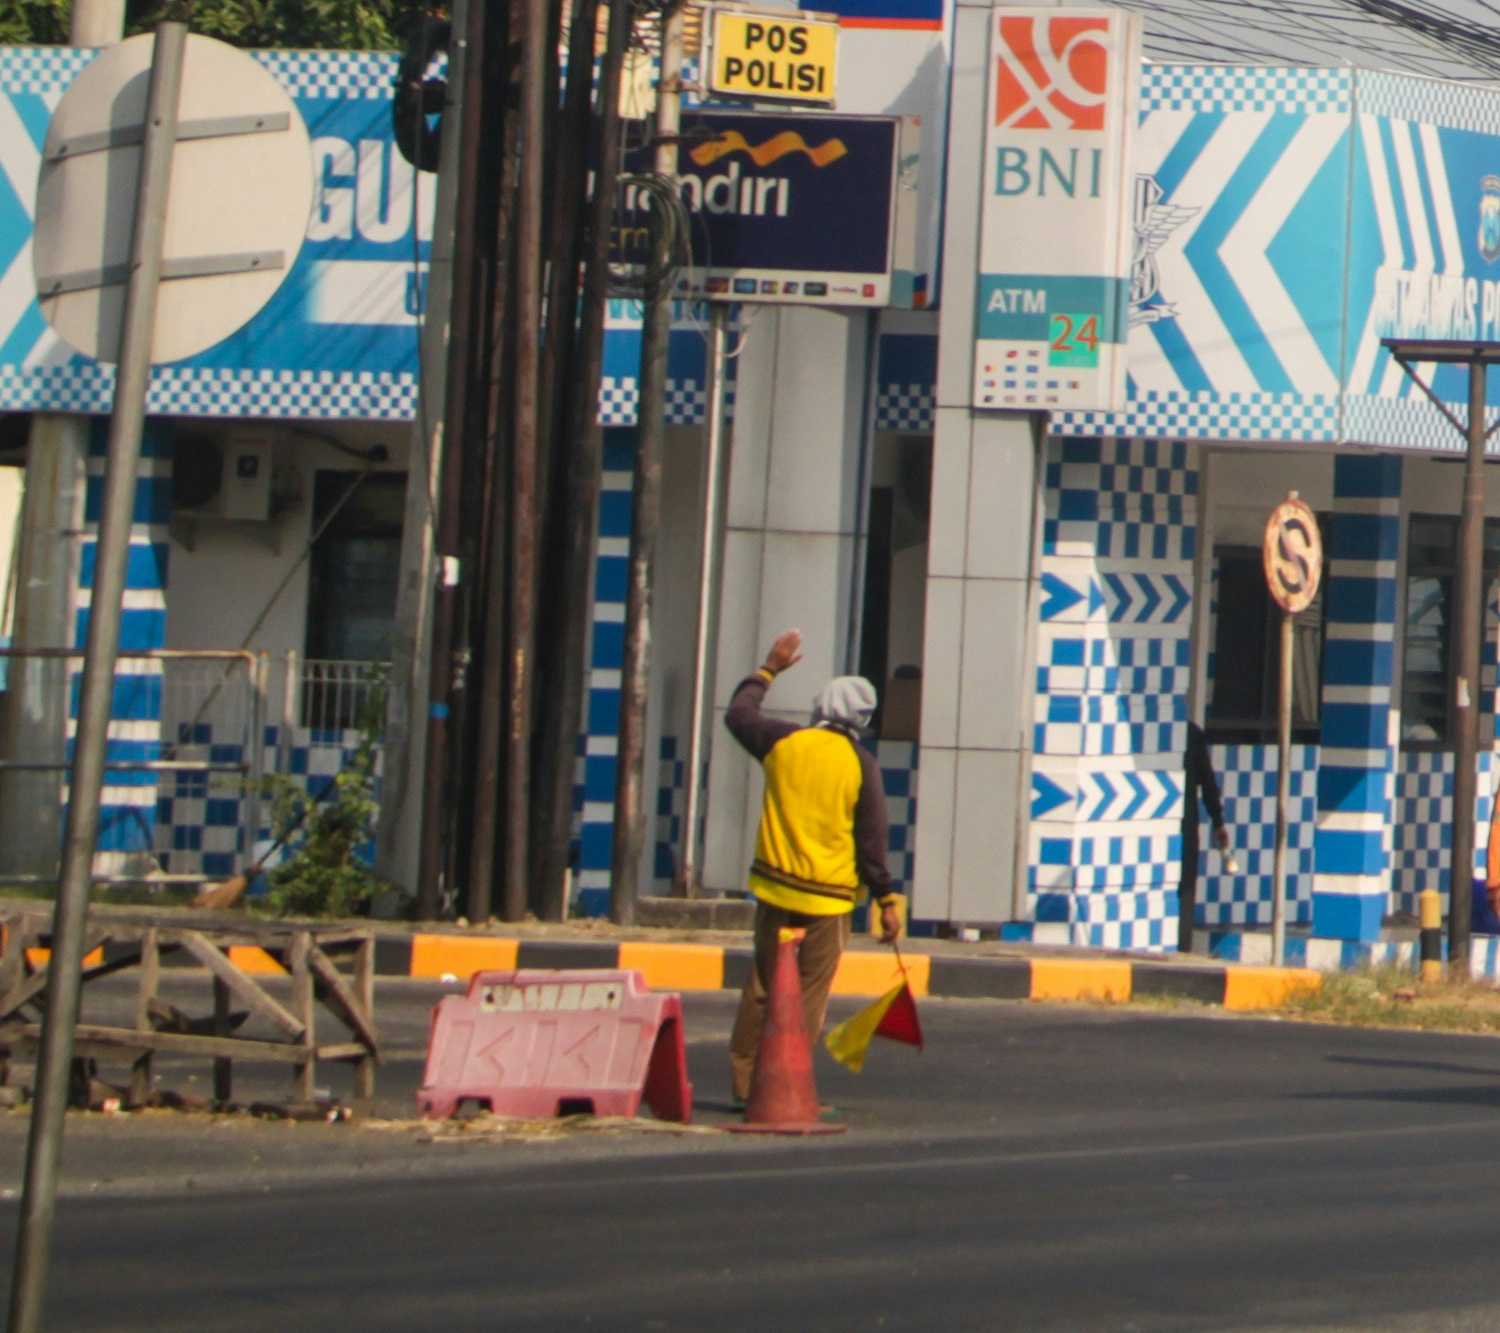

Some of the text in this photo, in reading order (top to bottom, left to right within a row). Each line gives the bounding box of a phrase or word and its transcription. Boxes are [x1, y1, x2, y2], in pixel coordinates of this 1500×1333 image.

[745, 22, 808, 55] POS
[724, 56, 825, 93] POLISI
[307, 135, 438, 243] GU
[993, 146, 1104, 199] BNI
[987, 288, 1047, 314] ATM
[1050, 314, 1099, 352] 24
